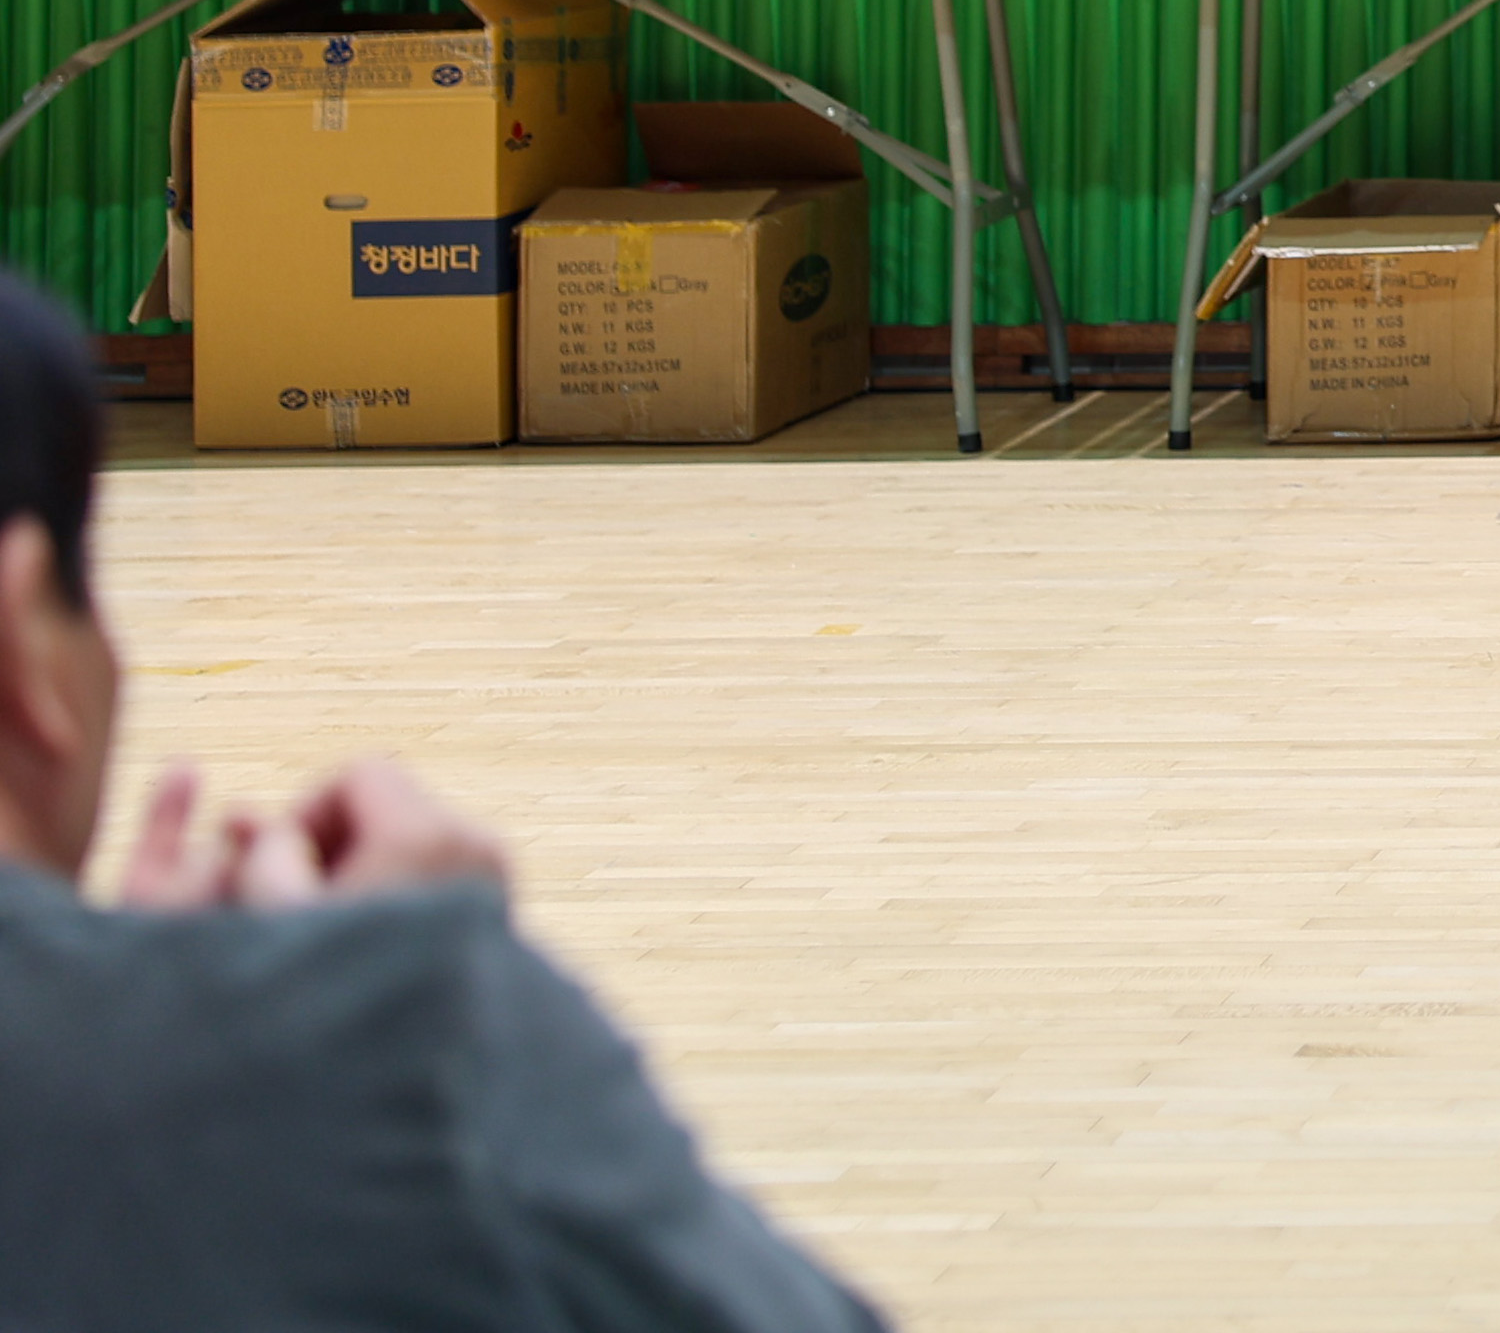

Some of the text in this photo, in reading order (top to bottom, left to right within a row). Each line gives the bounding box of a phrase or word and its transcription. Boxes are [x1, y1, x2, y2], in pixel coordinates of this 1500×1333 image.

[359, 243, 481, 275] 청정바다
[626, 299, 654, 314] PCS
[625, 320, 654, 333] KGS
[1376, 315, 1405, 329] KGS
[627, 339, 657, 353] KGS
[1377, 335, 1408, 349] KGS
[560, 382, 600, 396] MADE
[602, 381, 615, 394] IN
[1309, 378, 1348, 393] MADE
[1351, 377, 1365, 389] IN
